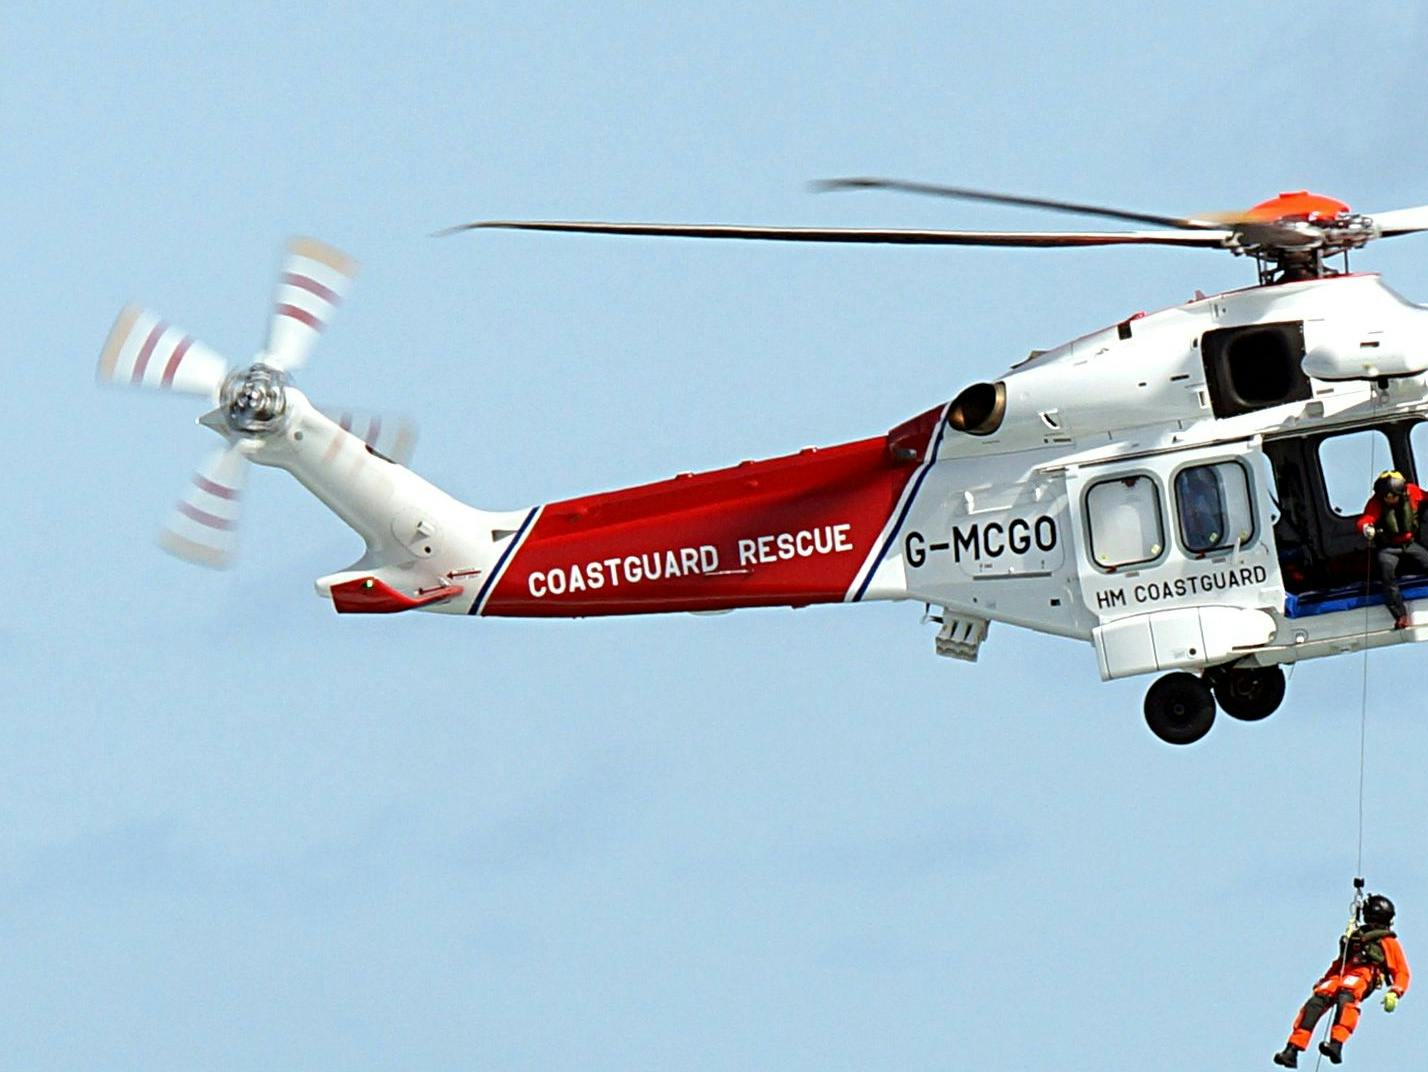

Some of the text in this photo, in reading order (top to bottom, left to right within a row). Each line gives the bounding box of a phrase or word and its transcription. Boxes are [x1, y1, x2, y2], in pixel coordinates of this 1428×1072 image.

[528, 524, 853, 597] COASTGUARD RESCUE
[905, 515, 1057, 568] G-MCGO
[1096, 565, 1267, 609] HM COASTGUARD
